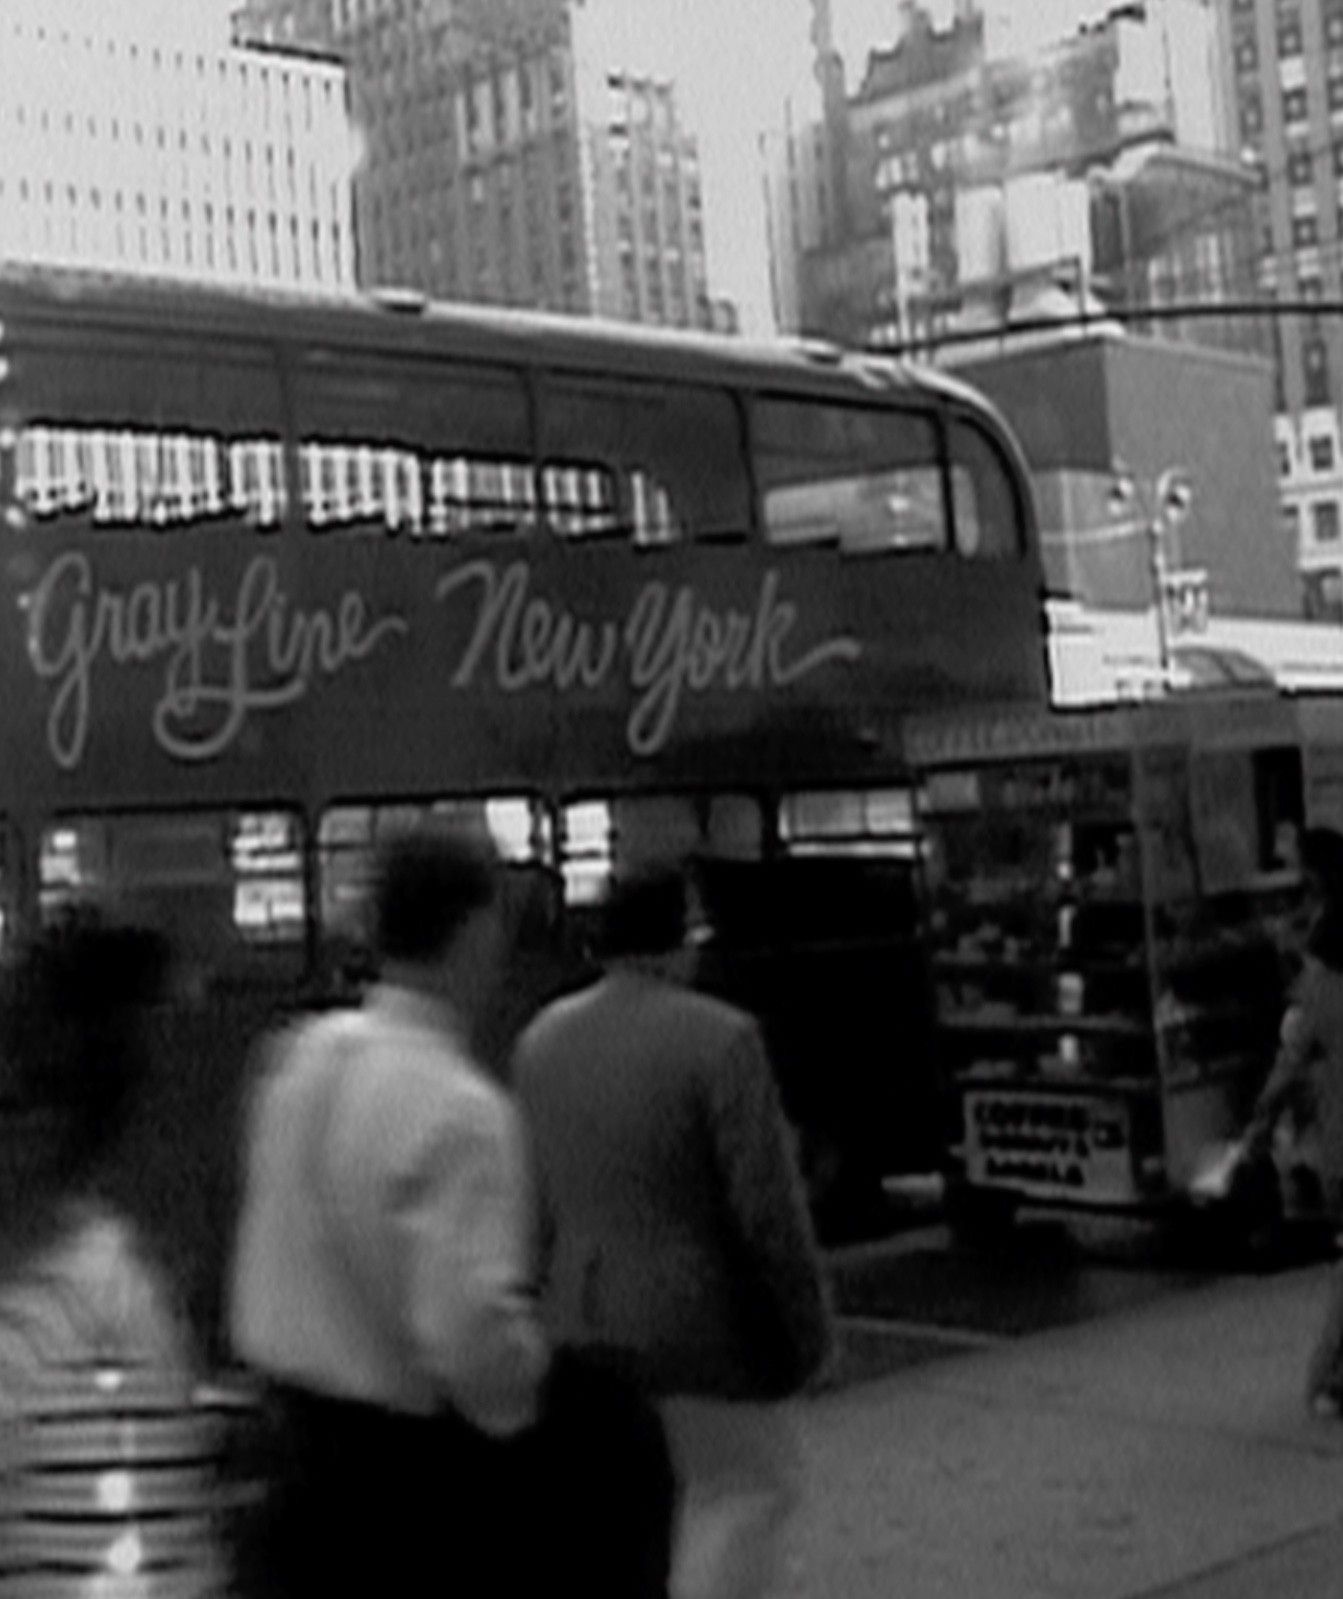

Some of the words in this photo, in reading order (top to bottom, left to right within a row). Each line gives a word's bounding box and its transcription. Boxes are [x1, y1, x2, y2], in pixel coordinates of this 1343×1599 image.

[27, 552, 217, 769] Gray
[153, 556, 407, 757] Line
[434, 560, 617, 690] New
[626, 567, 862, 756] York
